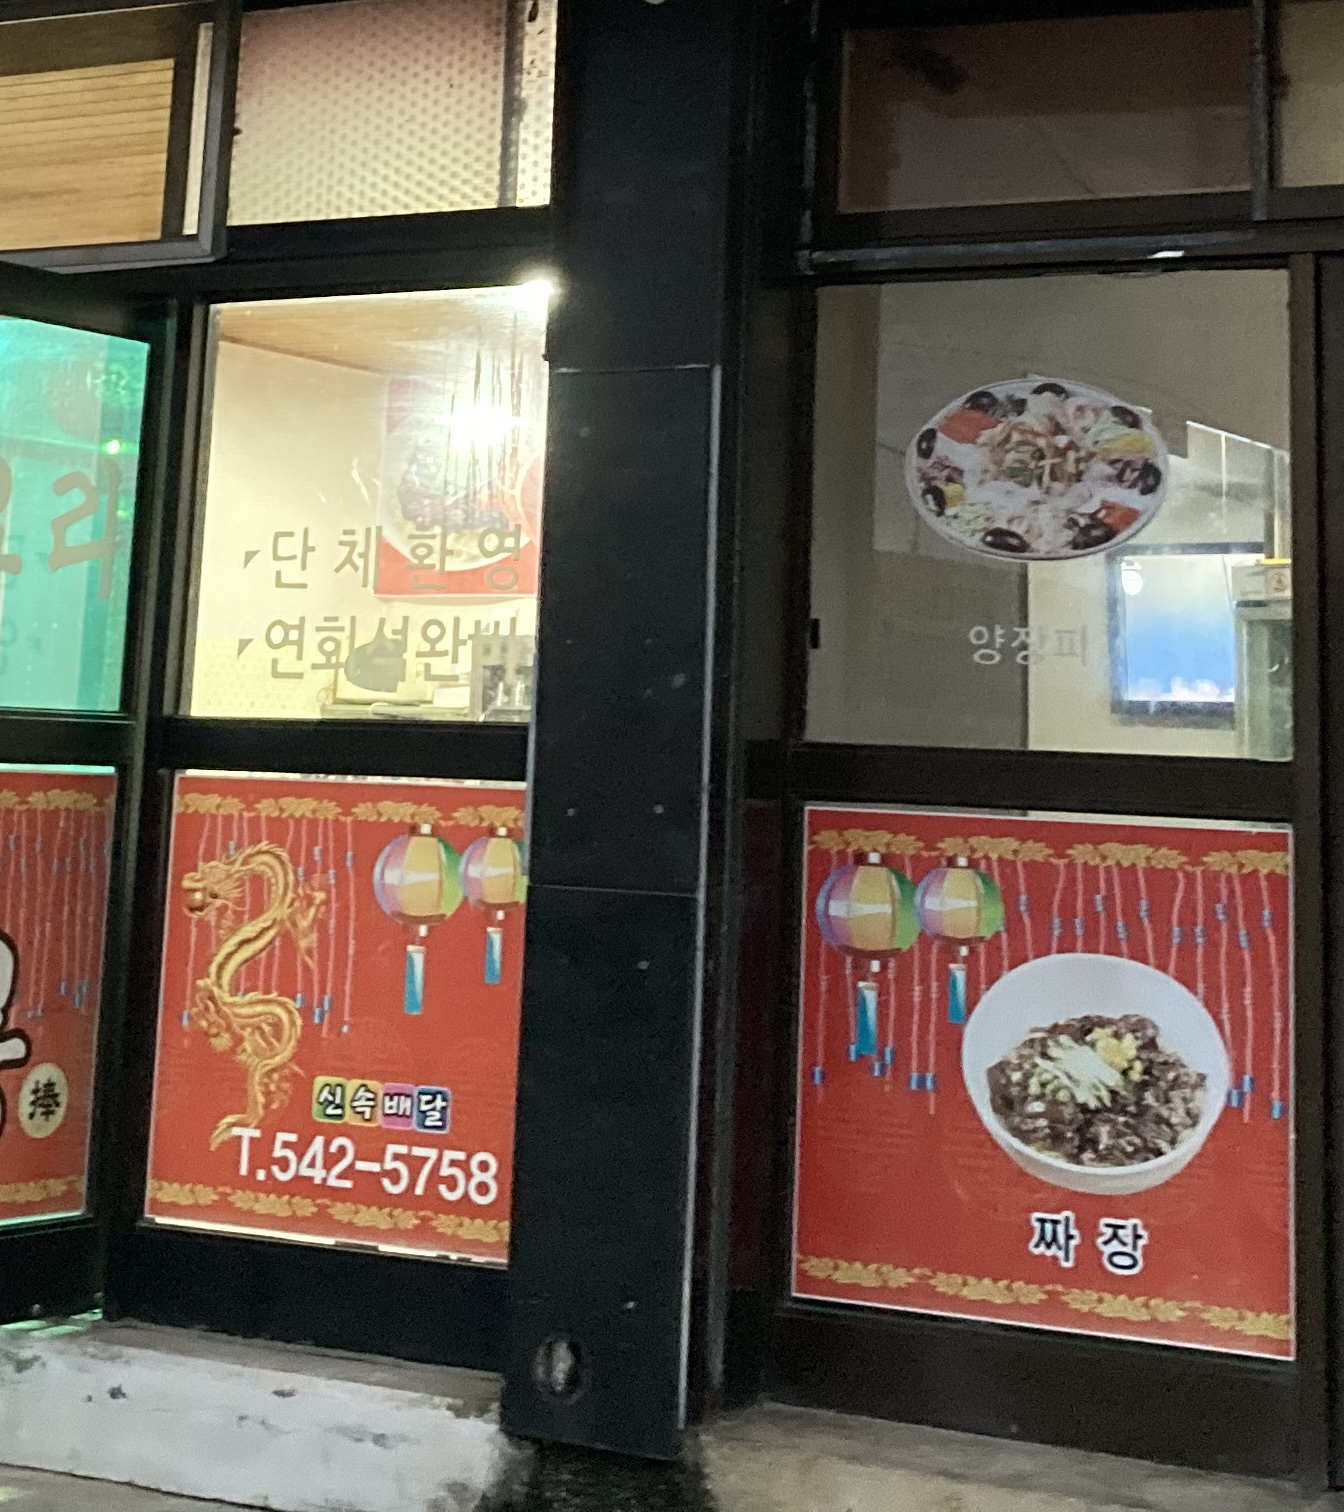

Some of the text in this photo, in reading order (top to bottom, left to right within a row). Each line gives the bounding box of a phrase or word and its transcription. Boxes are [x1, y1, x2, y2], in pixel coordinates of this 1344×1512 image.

[968, 623, 1089, 668] 양장피
[317, 1081, 448, 1129] 신속배달
[231, 1126, 500, 1207] T.542-5758
[1029, 1210, 1150, 1275] 짜장
